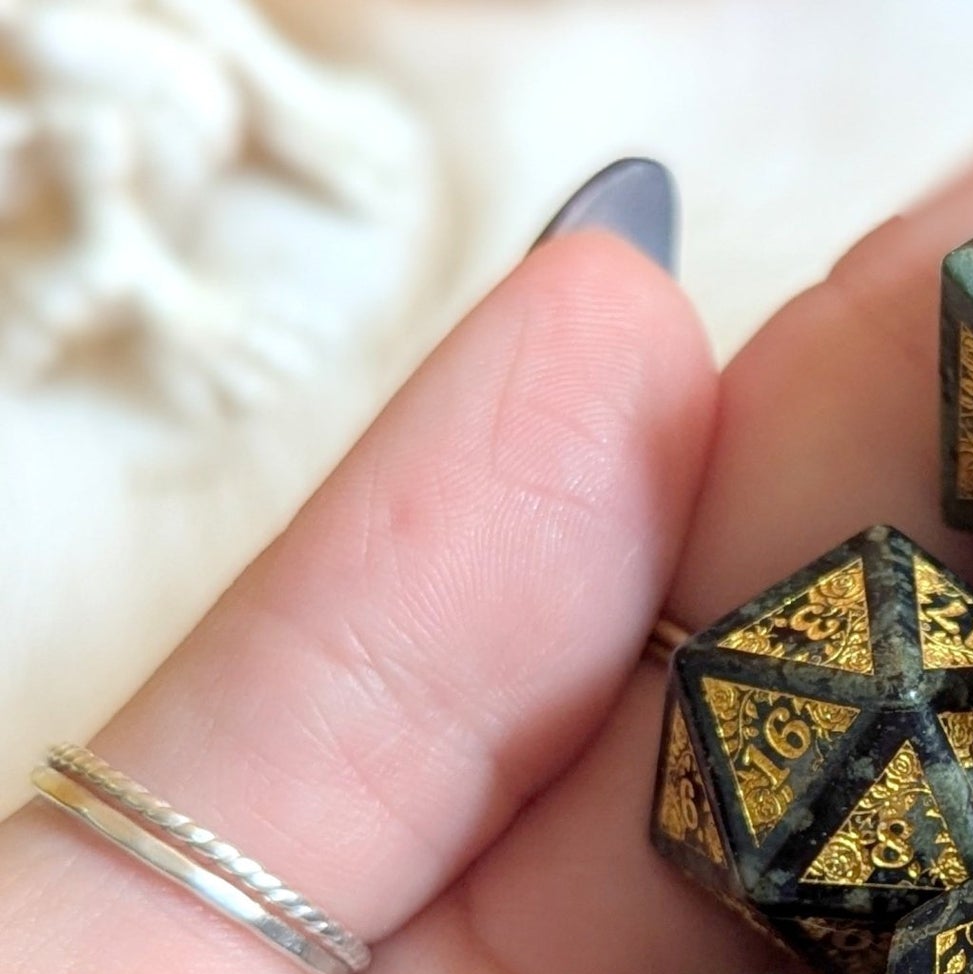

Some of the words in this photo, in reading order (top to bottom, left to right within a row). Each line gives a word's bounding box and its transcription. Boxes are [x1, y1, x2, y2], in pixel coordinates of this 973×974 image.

[789, 603, 841, 642] 3
[743, 705, 812, 792] 16
[870, 818, 917, 870] 8
